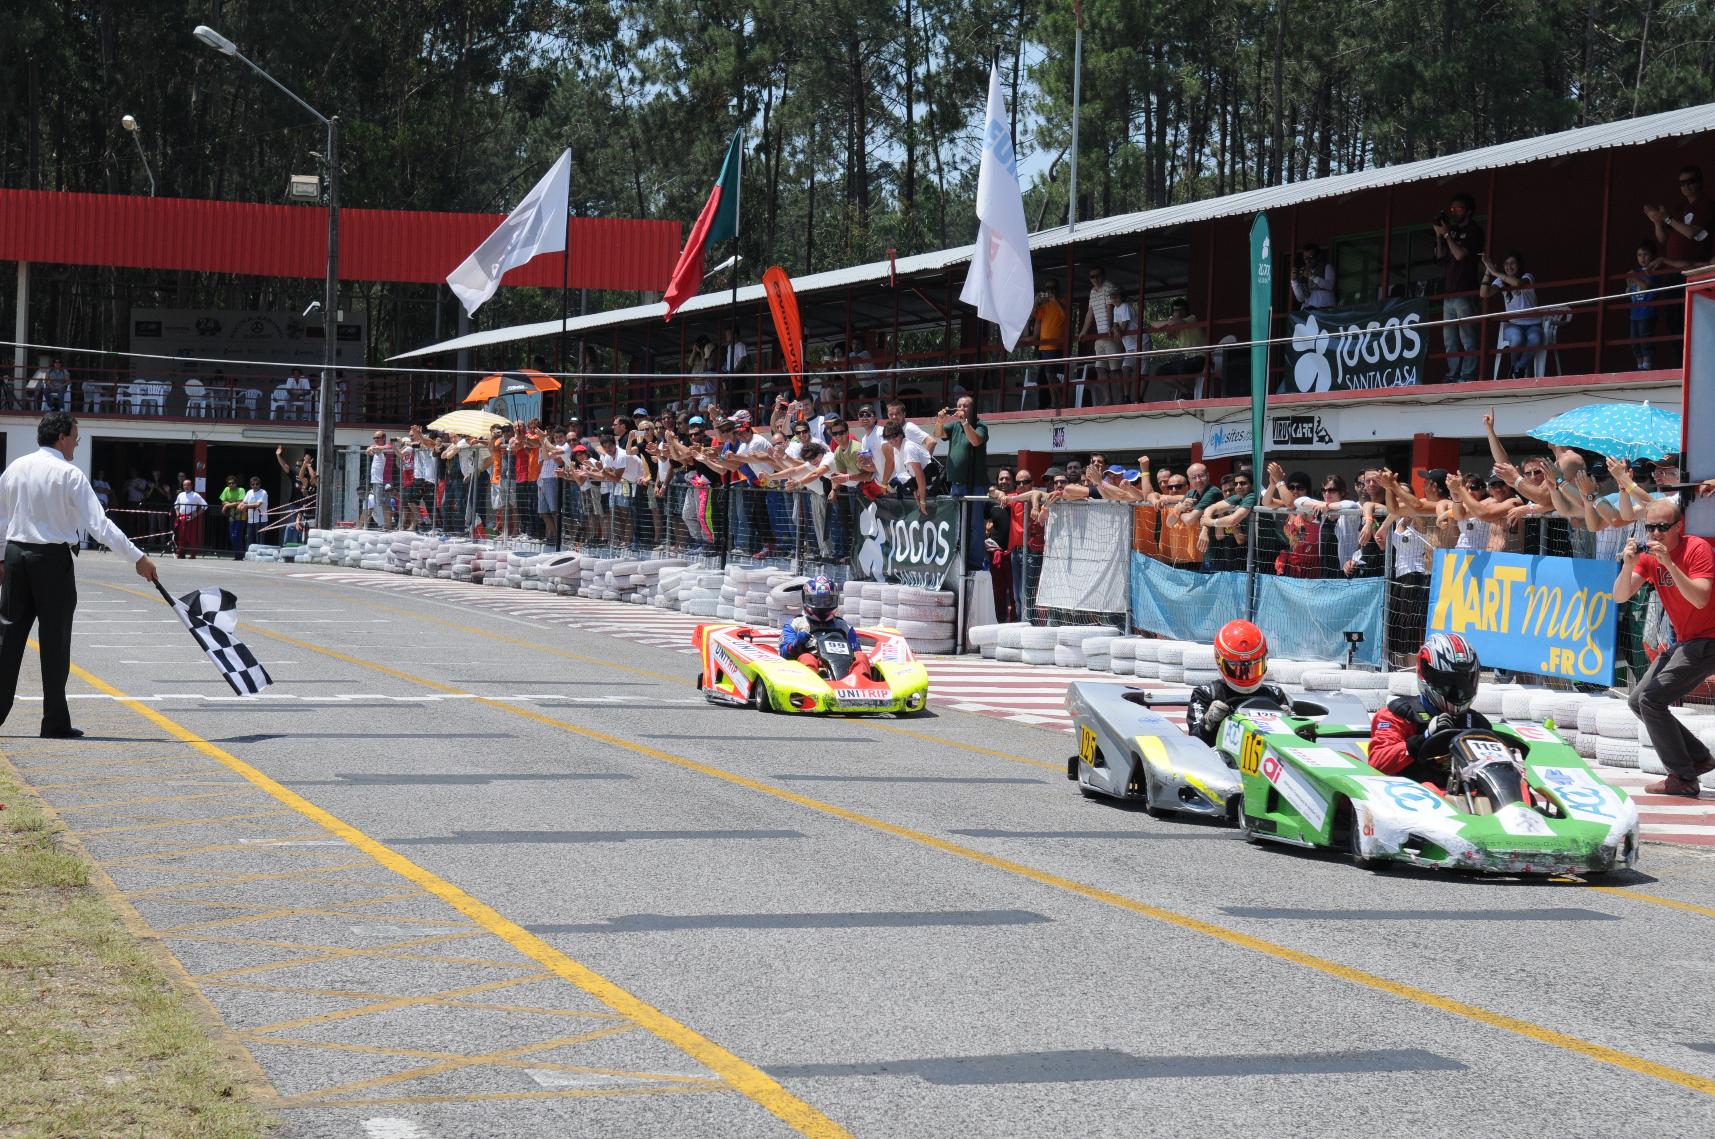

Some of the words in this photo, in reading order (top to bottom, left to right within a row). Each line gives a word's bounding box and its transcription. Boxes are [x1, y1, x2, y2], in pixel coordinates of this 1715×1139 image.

[1336, 313, 1421, 384] JOGOS
[887, 519, 950, 577] JOGOS
[1430, 553, 1527, 634] KART
[1521, 585, 1613, 676] mag
[715, 643, 738, 674] UNITRIP
[837, 688, 889, 699] UNITRIP
[1080, 725, 1096, 764] 125
[1242, 731, 1263, 774] 115
[1472, 742, 1502, 752] 115
